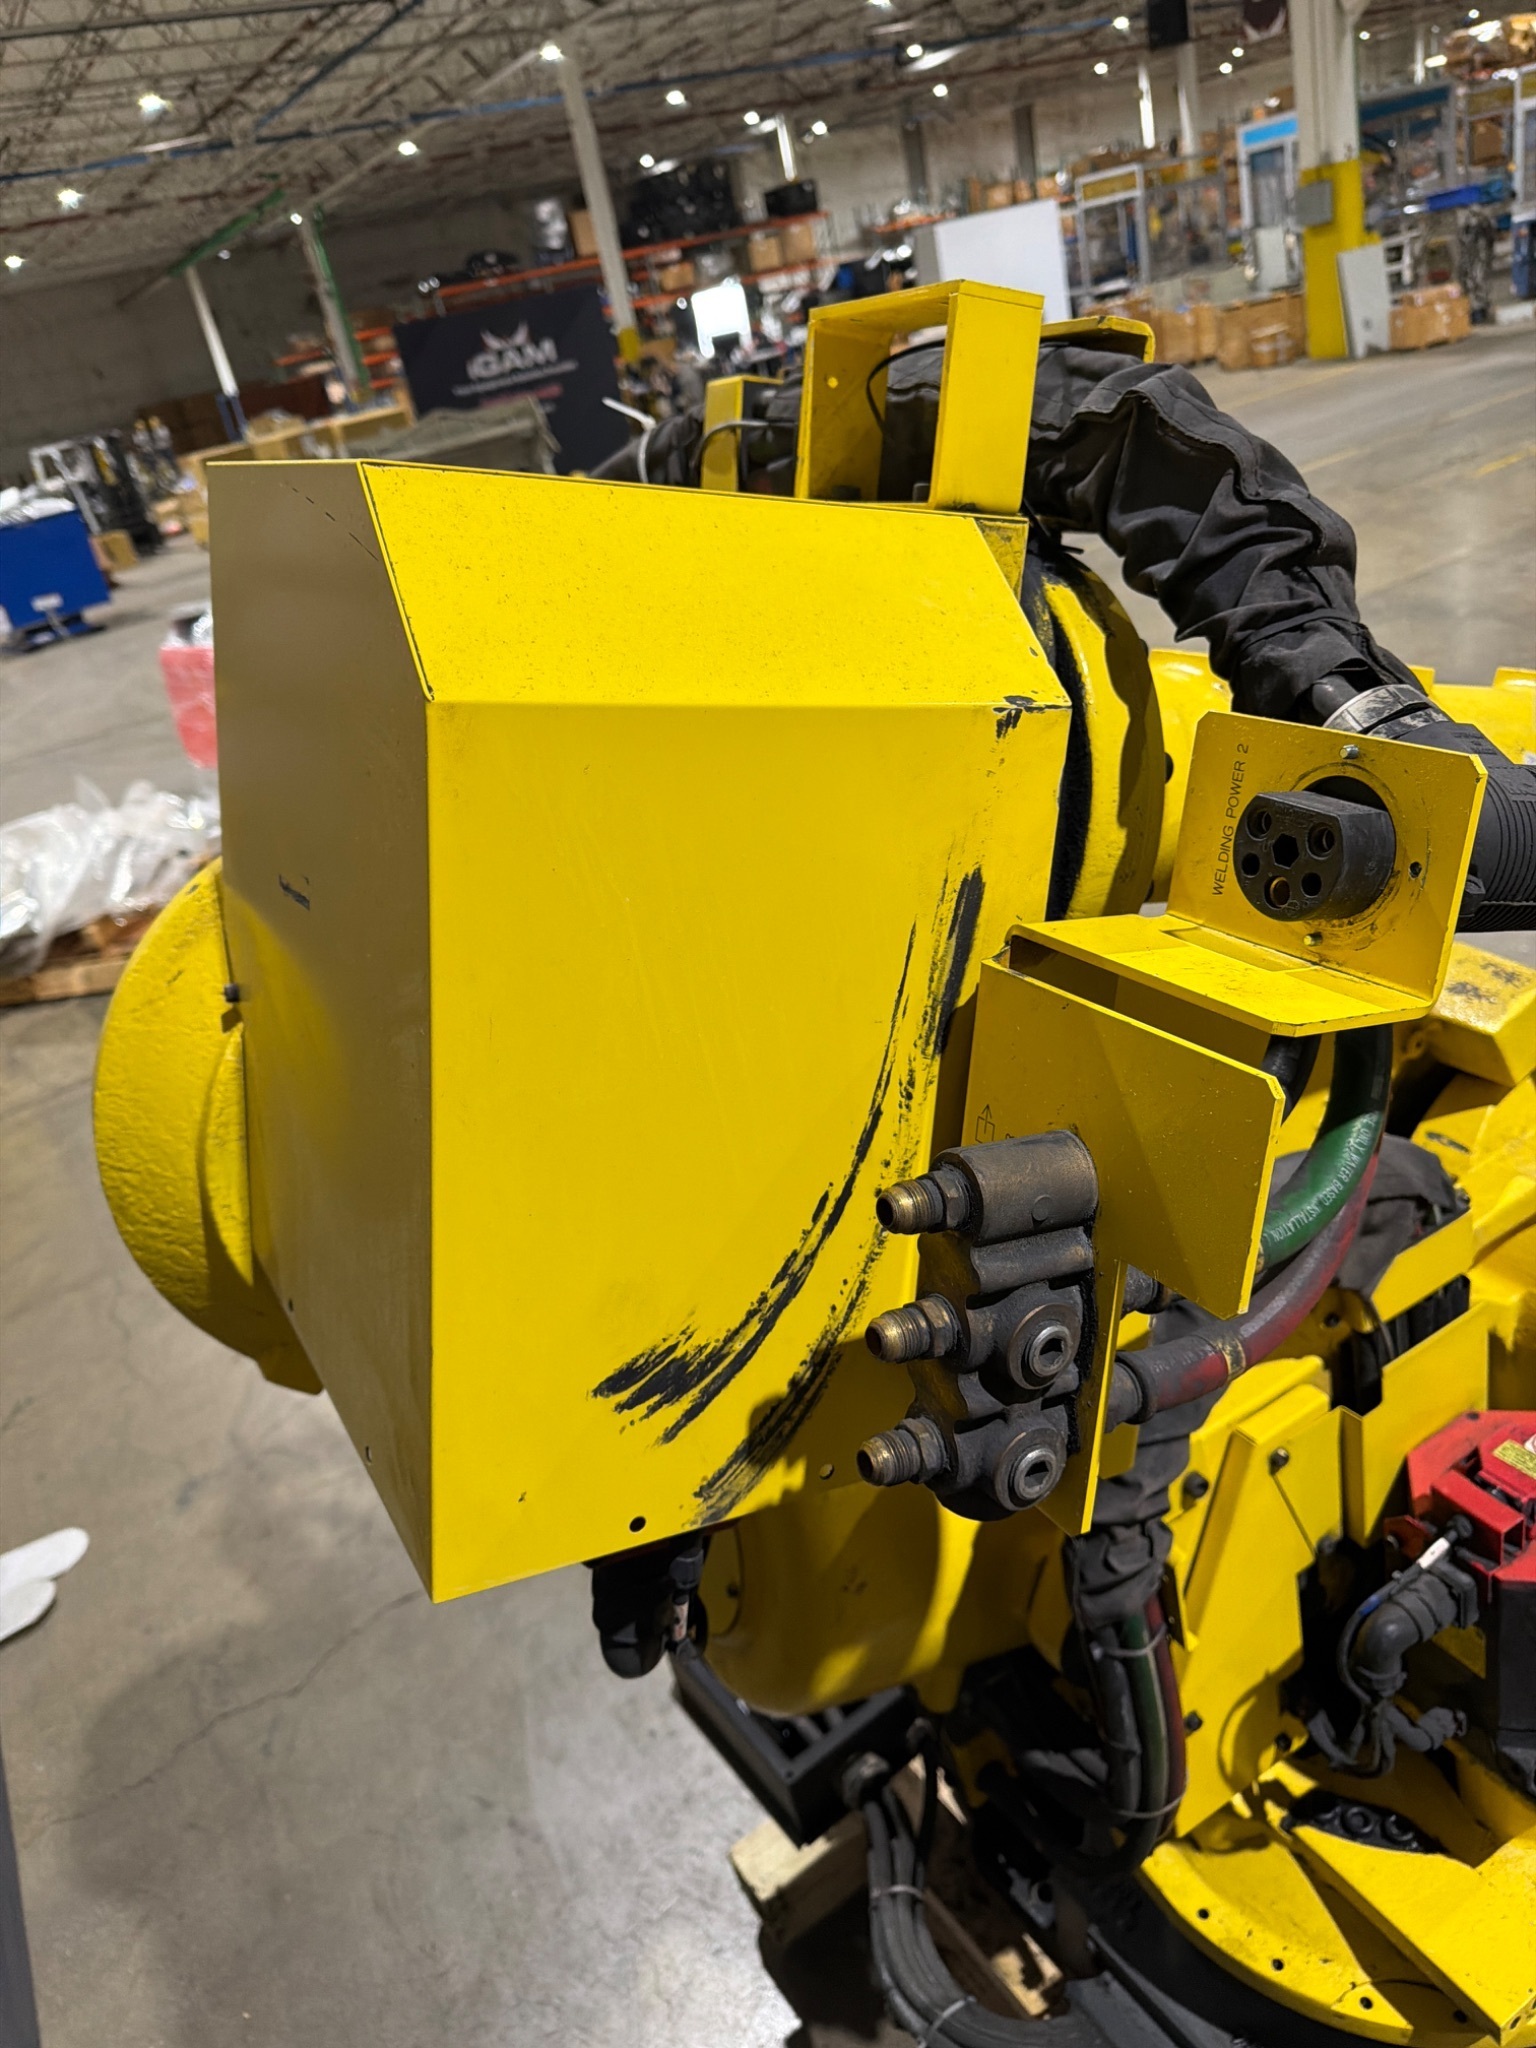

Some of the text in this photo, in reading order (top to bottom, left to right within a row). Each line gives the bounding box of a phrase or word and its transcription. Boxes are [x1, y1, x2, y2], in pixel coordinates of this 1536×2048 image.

[1212, 743, 1249, 896] WELDING POWER 2
[1338, 1153, 1361, 1183] WATER
[1319, 1179, 1344, 1206] BASED
